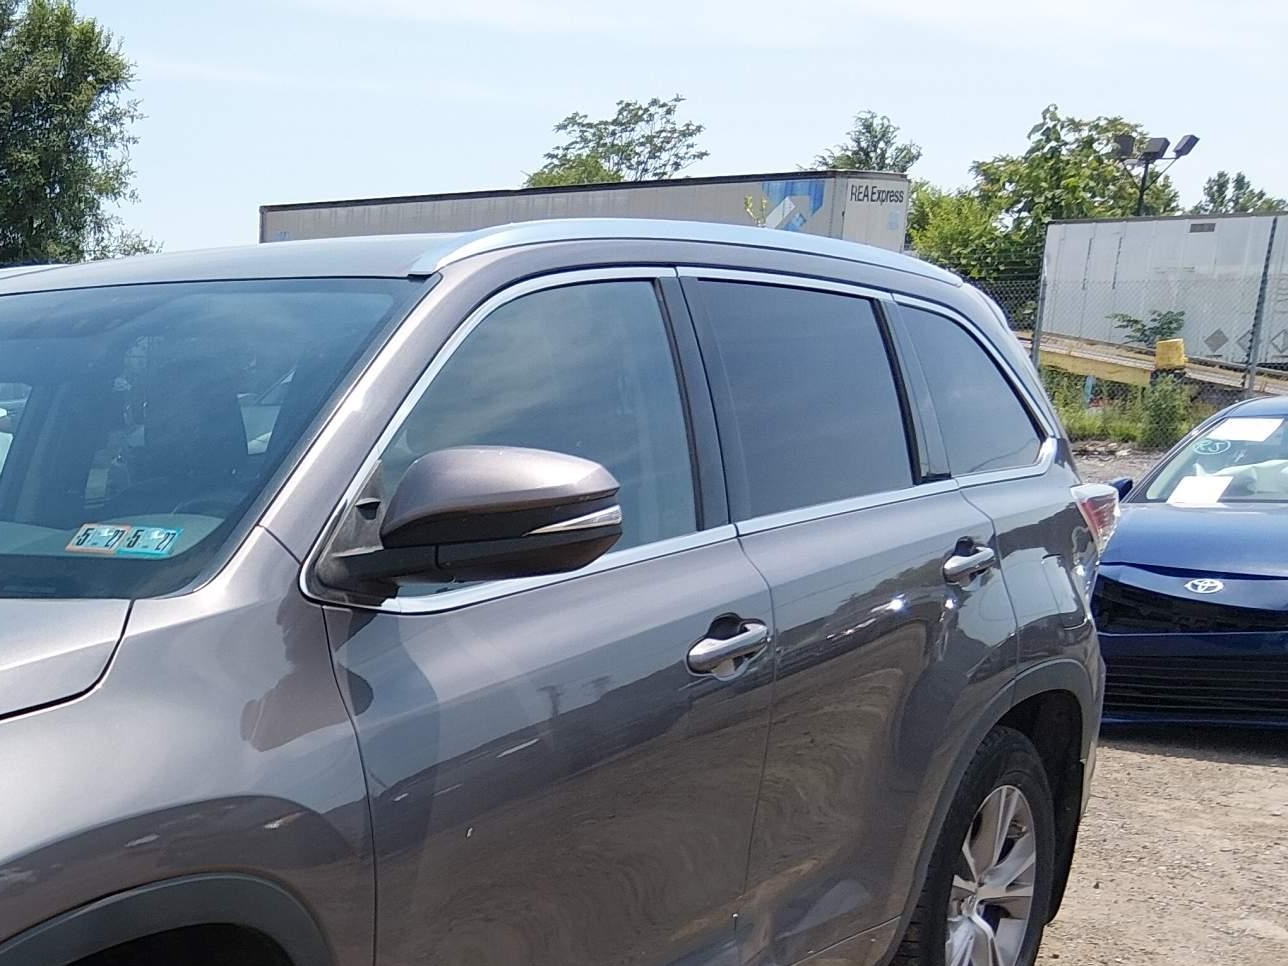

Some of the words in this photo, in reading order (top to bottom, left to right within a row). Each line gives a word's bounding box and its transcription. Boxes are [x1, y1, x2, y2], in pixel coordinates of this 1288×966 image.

[850, 184, 869, 202] REA
[870, 185, 904, 206] Express
[105, 529, 126, 550] 27
[155, 532, 177, 552] 27
